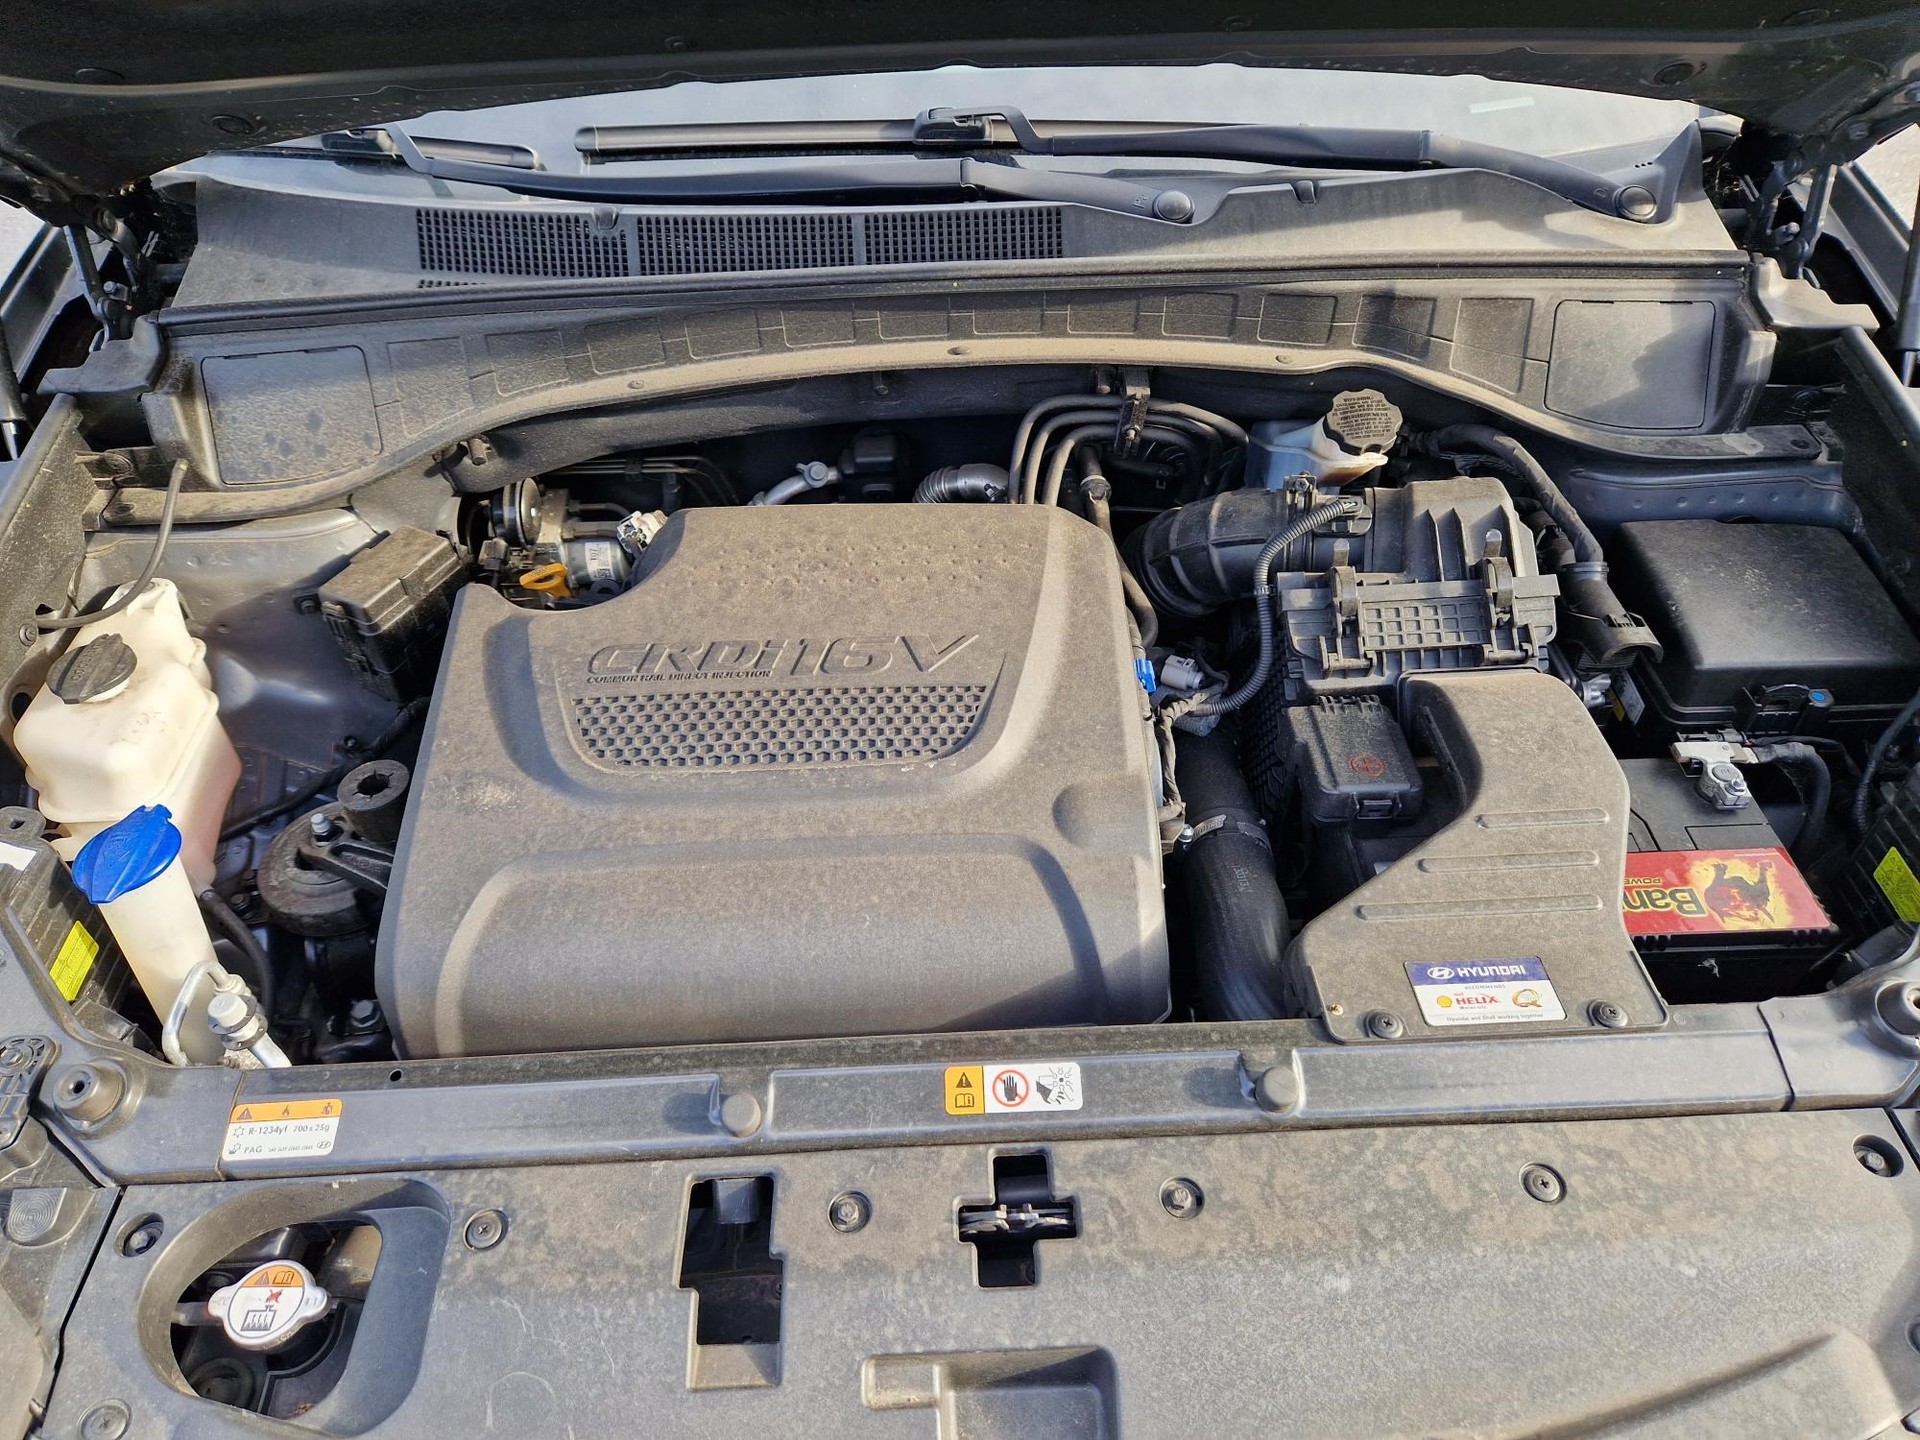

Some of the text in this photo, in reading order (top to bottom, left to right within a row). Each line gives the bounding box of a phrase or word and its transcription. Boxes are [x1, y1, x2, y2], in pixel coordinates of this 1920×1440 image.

[789, 634, 980, 677] 16V
[586, 670, 772, 684] COMMON RAIL DIRECT INJECTION
[1622, 888, 1706, 915] Ban
[1457, 964, 1526, 977] HYUNDAI
[1456, 995, 1499, 1005] HELIX
[248, 1125, 288, 1136] R-1234yf
[243, 1145, 263, 1153] PAG
